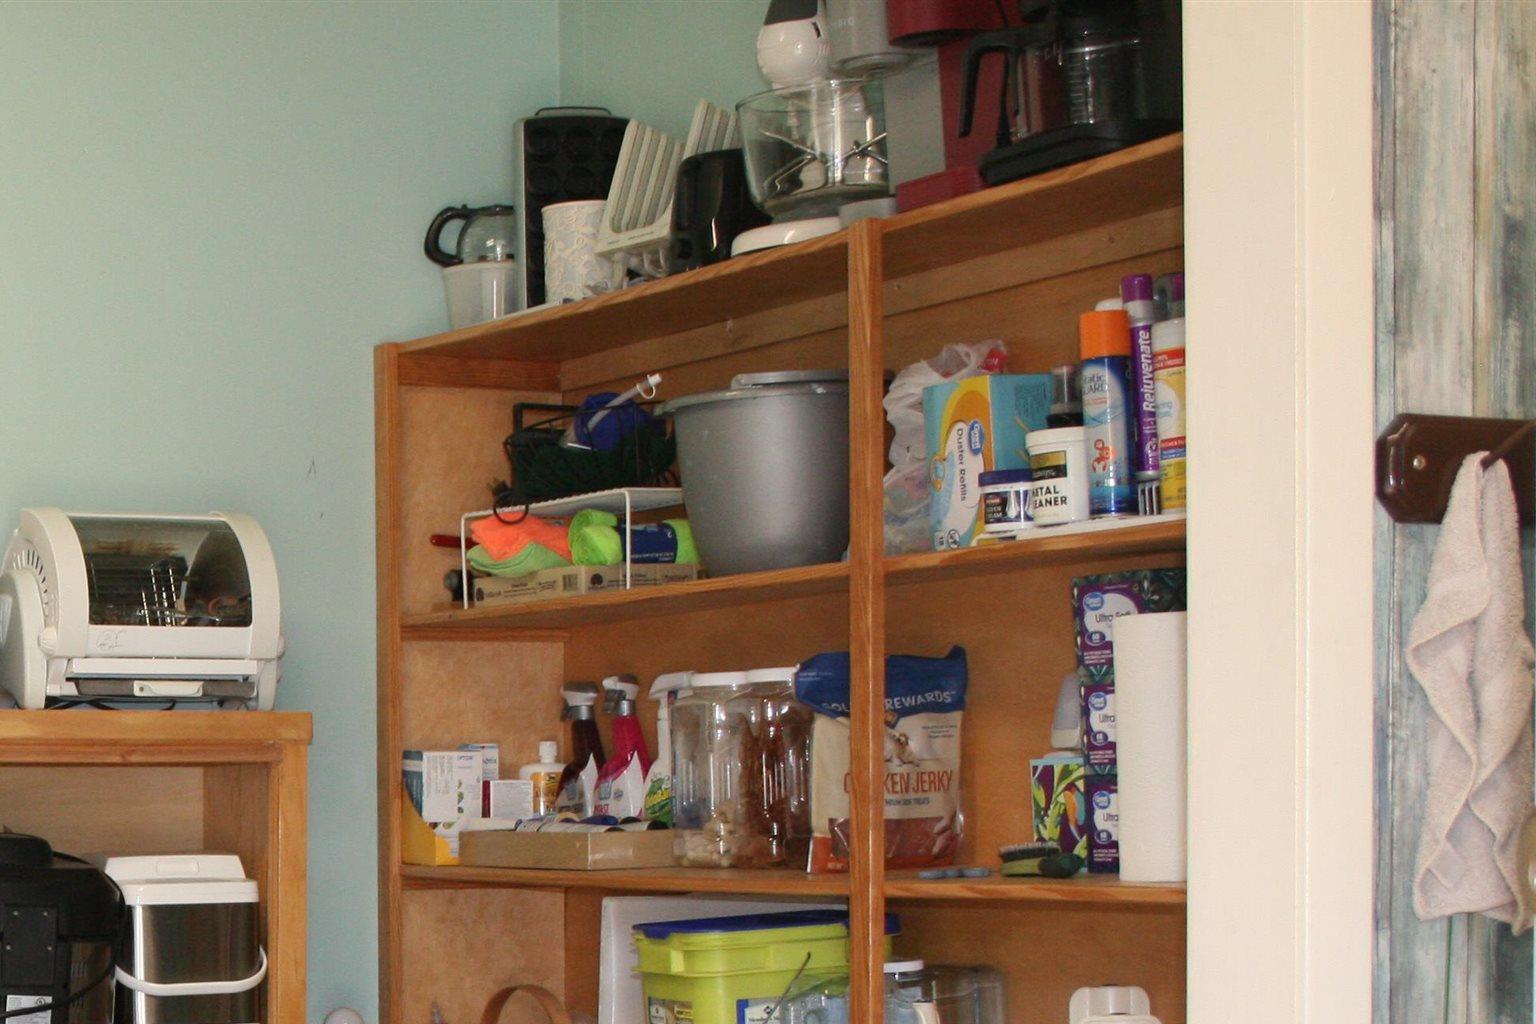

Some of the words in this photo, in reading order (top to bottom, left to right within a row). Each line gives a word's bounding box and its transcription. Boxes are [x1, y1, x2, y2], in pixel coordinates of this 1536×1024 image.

[1139, 330, 1156, 412] Rejuvenate
[956, 428, 965, 466] Duster
[960, 468, 968, 502] Refills
[1034, 496, 1068, 510] EANER
[1094, 613, 1114, 624] Ultra
[884, 690, 952, 711] REWARDS
[913, 769, 953, 794] JERKY
